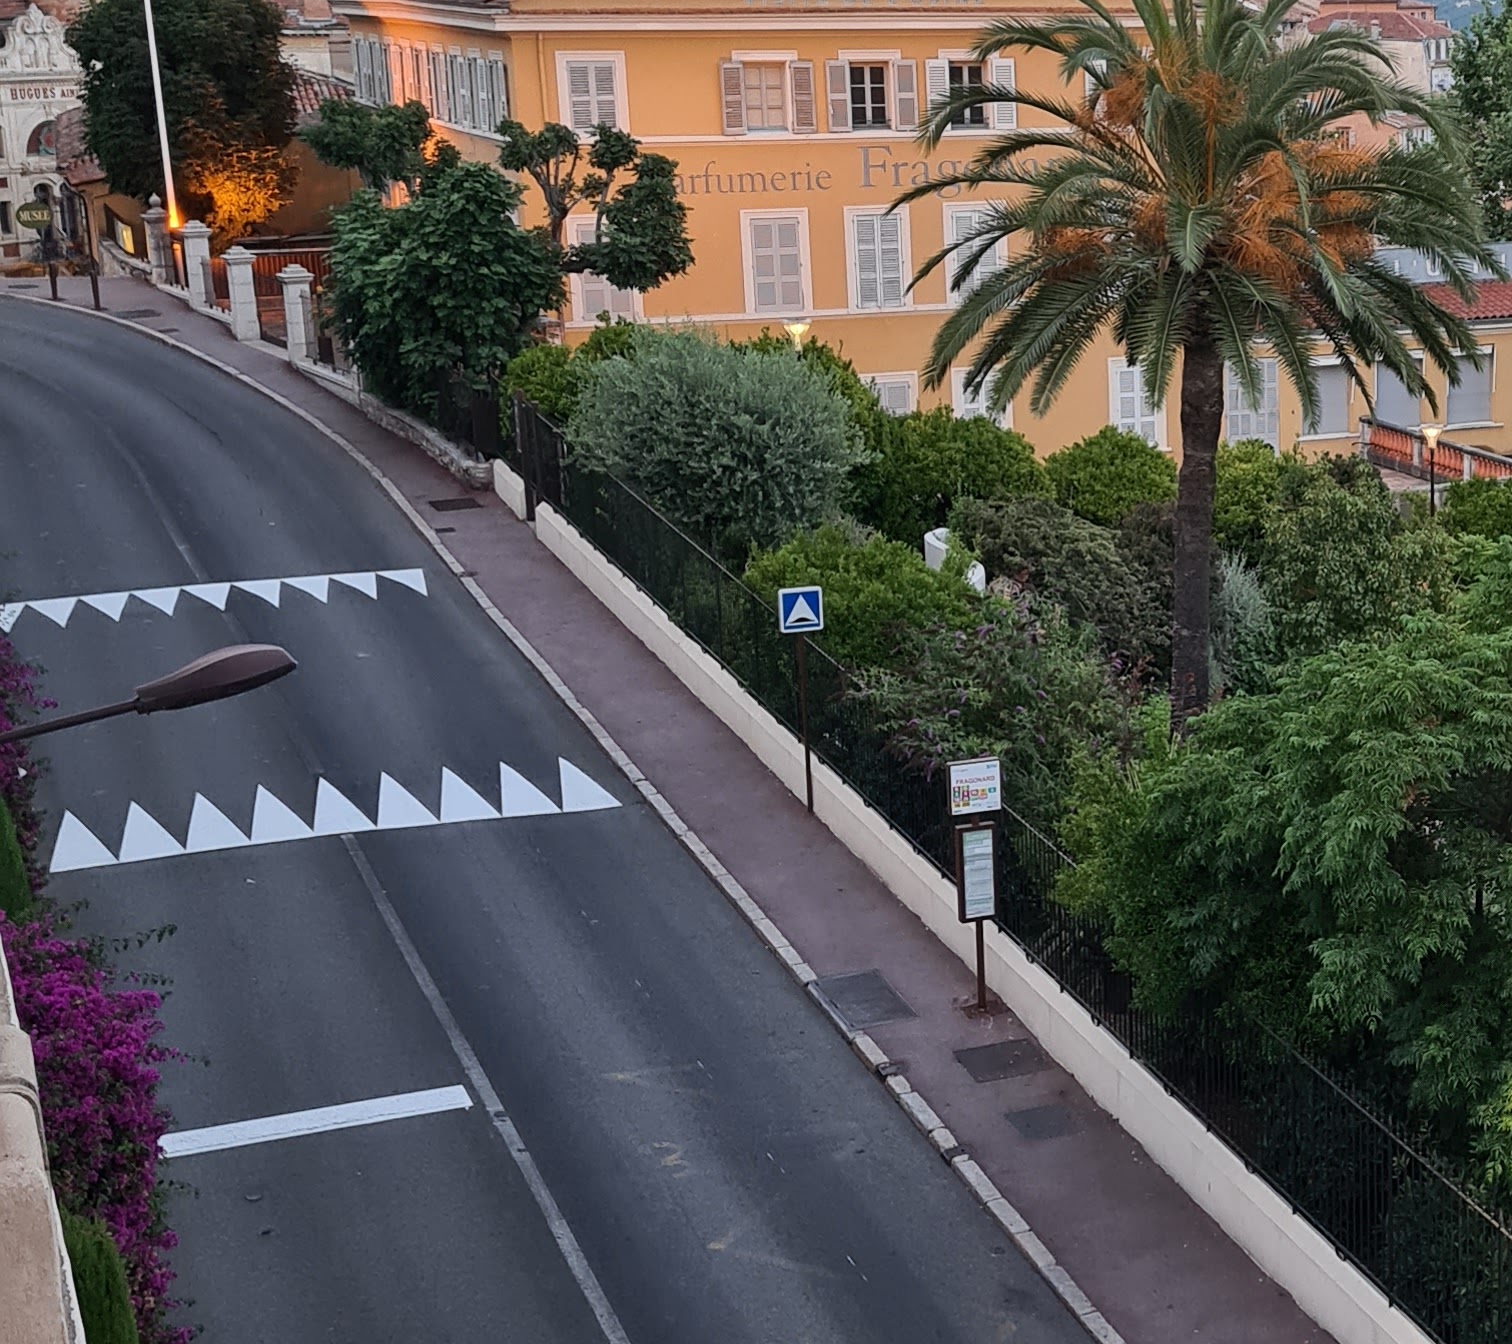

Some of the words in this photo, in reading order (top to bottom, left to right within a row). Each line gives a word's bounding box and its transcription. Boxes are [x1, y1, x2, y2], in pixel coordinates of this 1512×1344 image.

[10, 87, 56, 100] HUGUES
[60, 88, 79, 98] AIN
[673, 160, 833, 195] arfumerie
